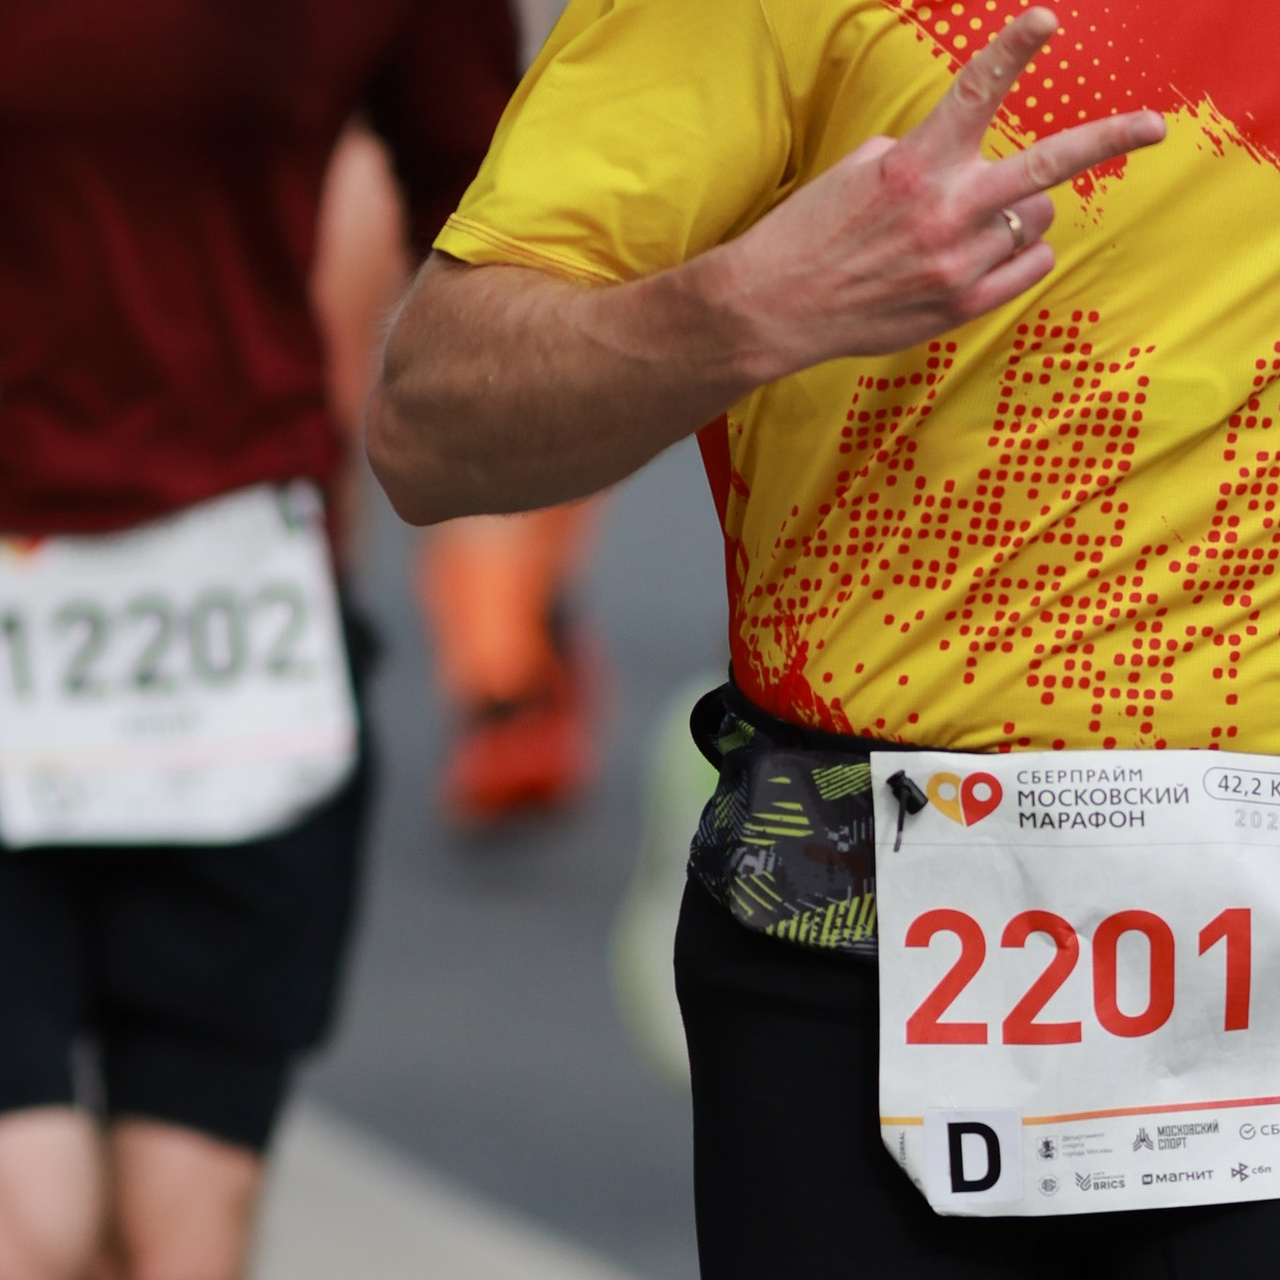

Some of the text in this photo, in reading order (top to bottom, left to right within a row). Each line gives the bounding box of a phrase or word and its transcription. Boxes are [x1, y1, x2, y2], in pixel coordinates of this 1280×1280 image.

[0, 583, 314, 703] 12202
[1017, 766, 1143, 784] СБЕРПРАЙМ
[1018, 783, 1189, 807] МОСКОВСКИЙ
[1218, 775, 1262, 796] 42,2
[1020, 810, 1145, 829] МАРАФОН
[1157, 1120, 1219, 1138] МОСКОВСКИЙ
[1158, 1137, 1187, 1150] СПОРТ
[947, 1122, 1001, 1193] D
[1093, 1180, 1125, 1190] BRICS
